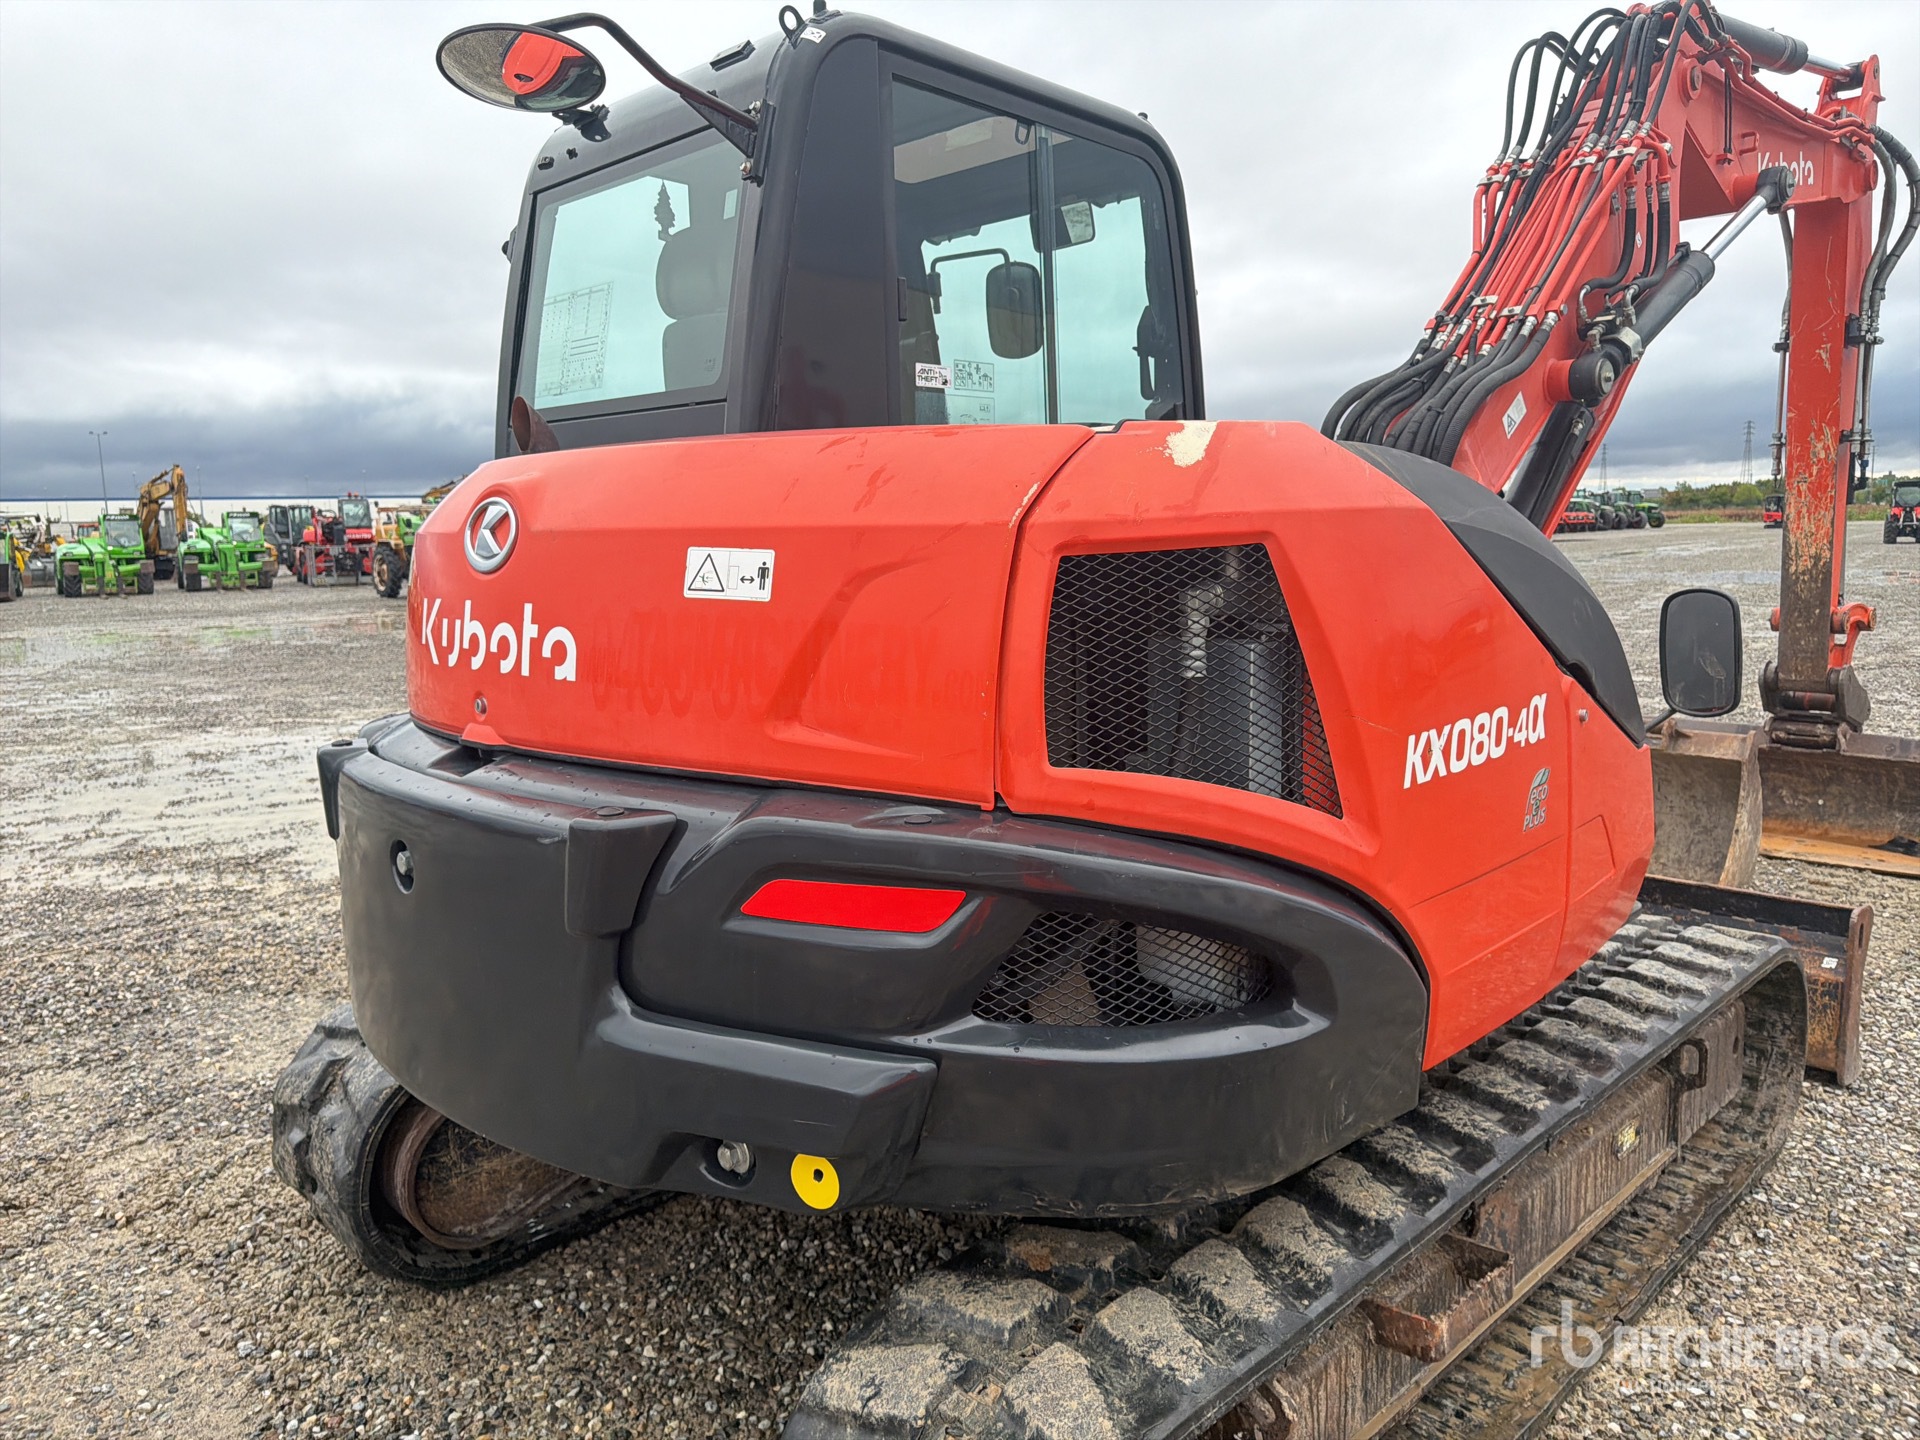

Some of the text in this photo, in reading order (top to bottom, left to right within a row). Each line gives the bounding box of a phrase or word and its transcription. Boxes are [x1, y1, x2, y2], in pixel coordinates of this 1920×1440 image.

[1758, 151, 1814, 185] Kota
[917, 375, 938, 383] THEFT
[421, 598, 577, 682] Kubota
[1530, 785, 1549, 804] eco
[1523, 807, 1547, 832] PLUS
